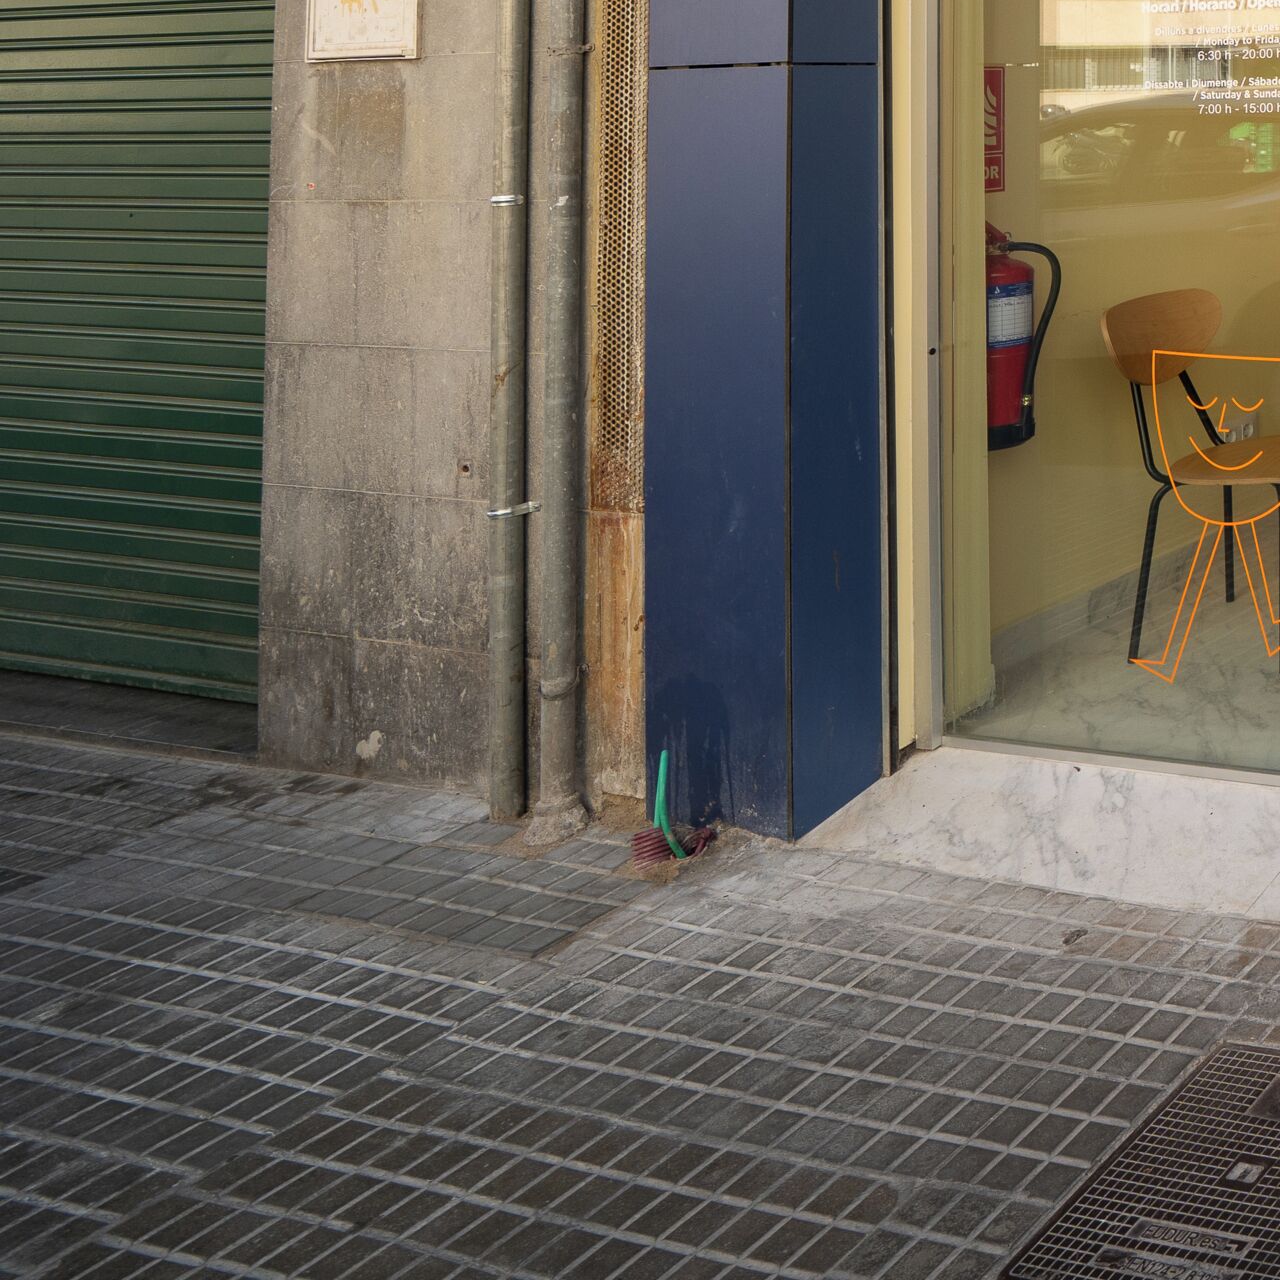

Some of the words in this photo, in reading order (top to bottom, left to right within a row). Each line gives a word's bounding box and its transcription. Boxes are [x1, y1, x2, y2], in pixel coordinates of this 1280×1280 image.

[1203, 37, 1240, 48] Monday
[1242, 37, 1253, 45] to
[1197, 50, 1222, 61] 6:30
[1224, 49, 1232, 60] h
[1242, 48, 1273, 60] 20:00
[1144, 79, 1183, 90] Dissabte
[1192, 78, 1238, 90] Diumenge
[1200, 91, 1241, 101] Saturday
[1244, 90, 1250, 99] &
[1198, 104, 1222, 114] 7:00
[1224, 103, 1232, 113] h
[1243, 102, 1273, 113] 15:00
